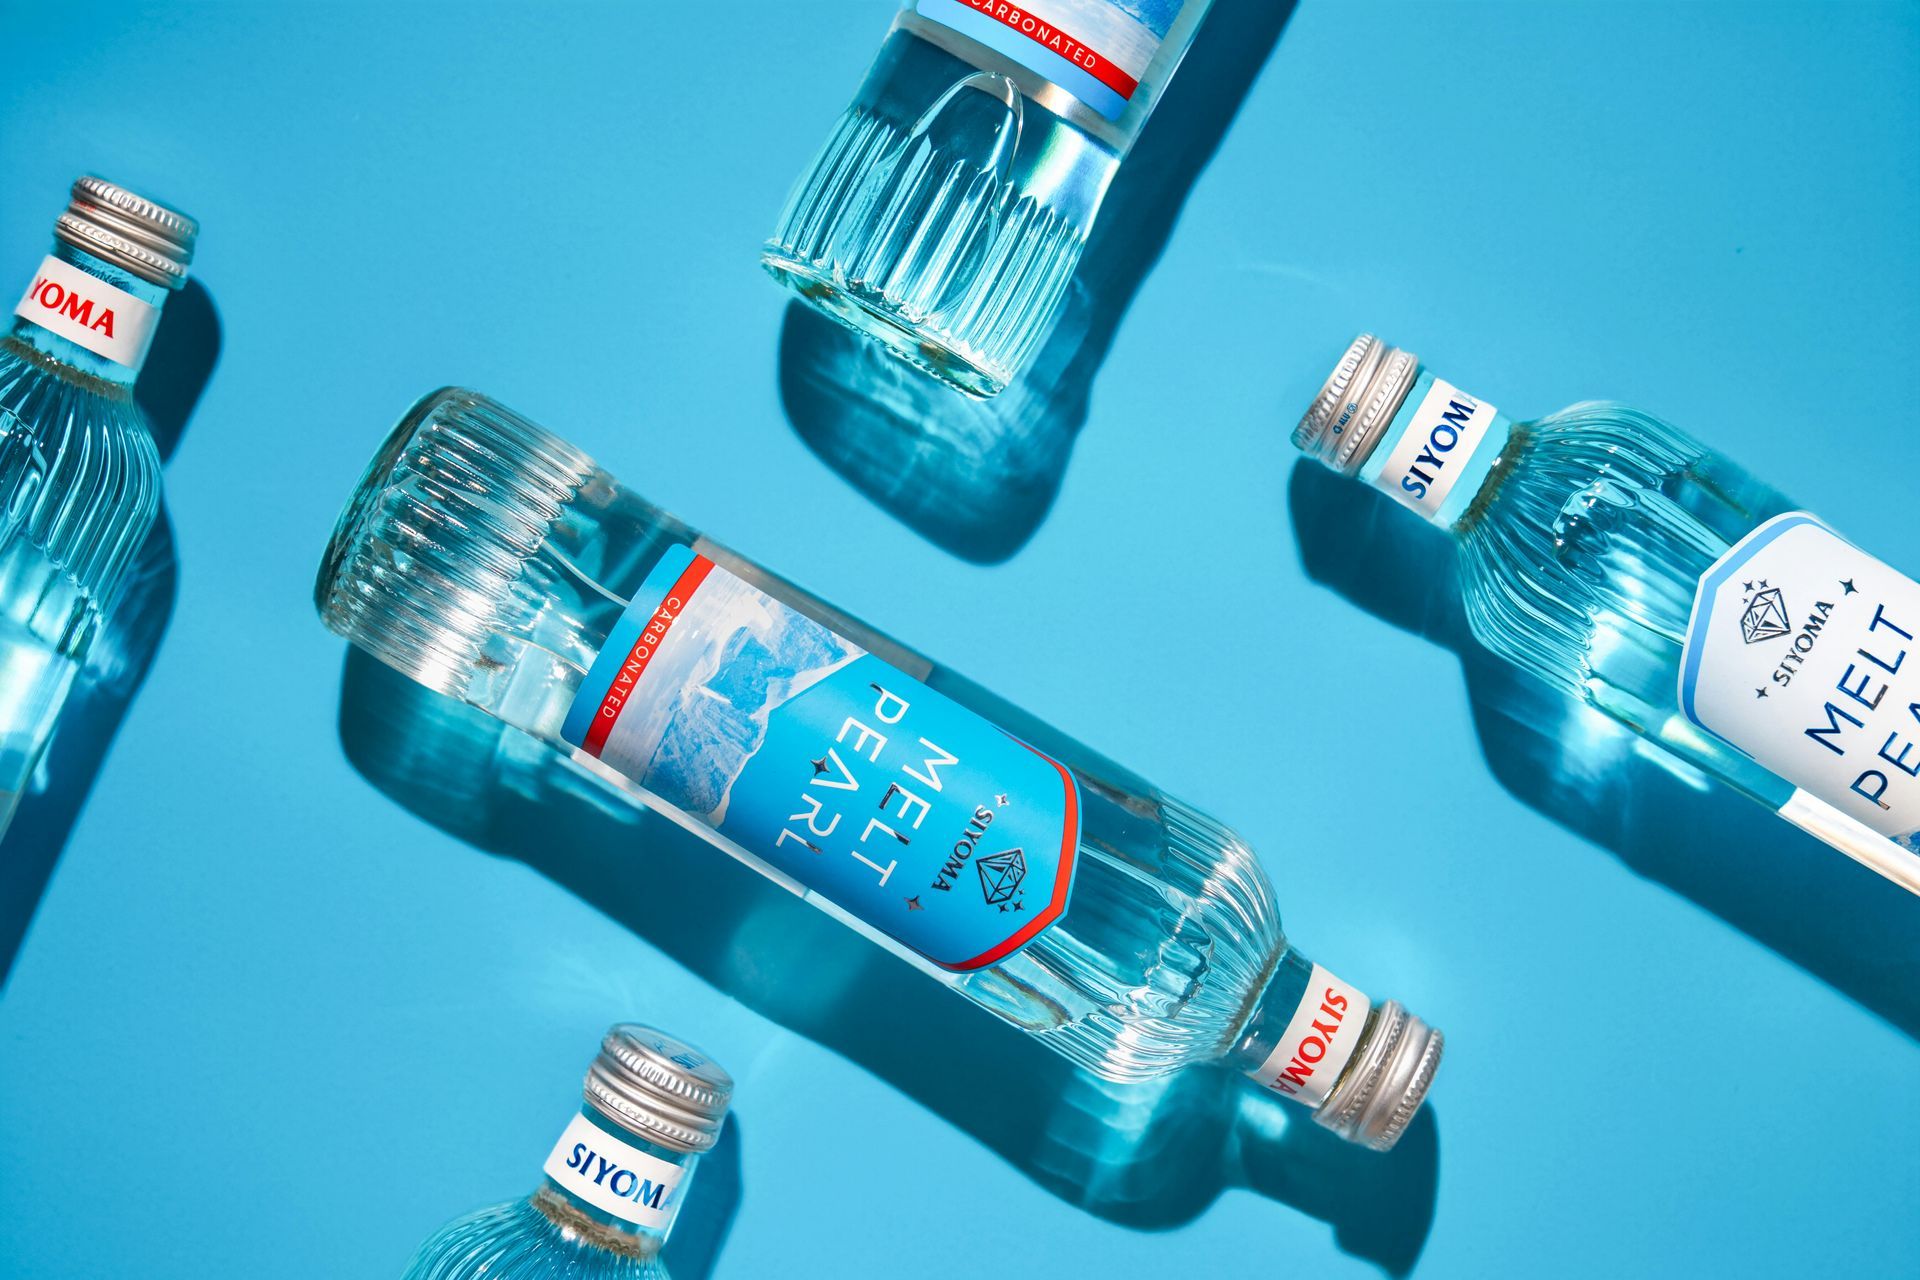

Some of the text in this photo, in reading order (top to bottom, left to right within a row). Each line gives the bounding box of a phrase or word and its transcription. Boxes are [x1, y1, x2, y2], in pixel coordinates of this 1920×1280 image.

[602, 597, 681, 718] CARBONATED
[1773, 600, 1834, 687] SIYOMA
[1804, 603, 1914, 756] MELT
[775, 682, 911, 855] PEARL
[851, 737, 960, 887] MELT
[1850, 701, 1920, 811] PE
[931, 804, 994, 892] SIYOMA
[1270, 988, 1348, 1094] SIYOMA
